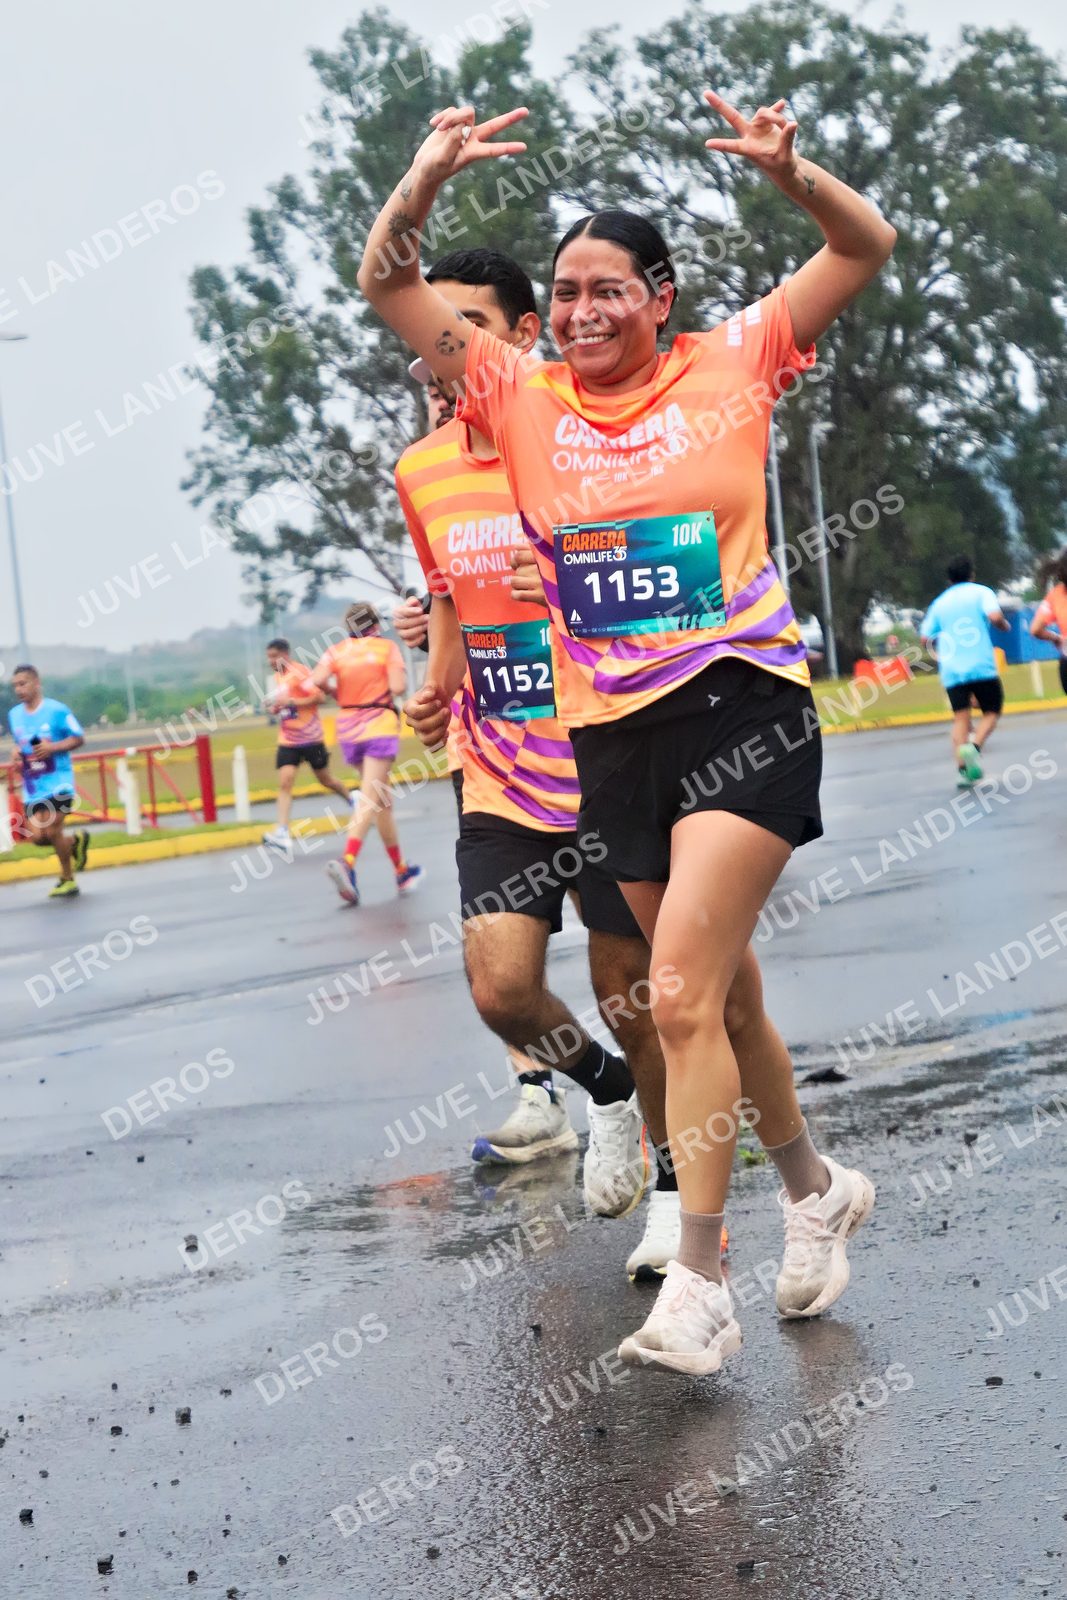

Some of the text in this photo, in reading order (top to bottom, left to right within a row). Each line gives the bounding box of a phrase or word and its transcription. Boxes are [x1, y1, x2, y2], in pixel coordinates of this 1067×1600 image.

[562, 530, 627, 552] CARRERA
[672, 522, 703, 547] 10K
[450, 550, 518, 576] OMNIL
[584, 566, 680, 604] 1153
[467, 633, 505, 648] CARRERA
[483, 662, 553, 693] 1152
